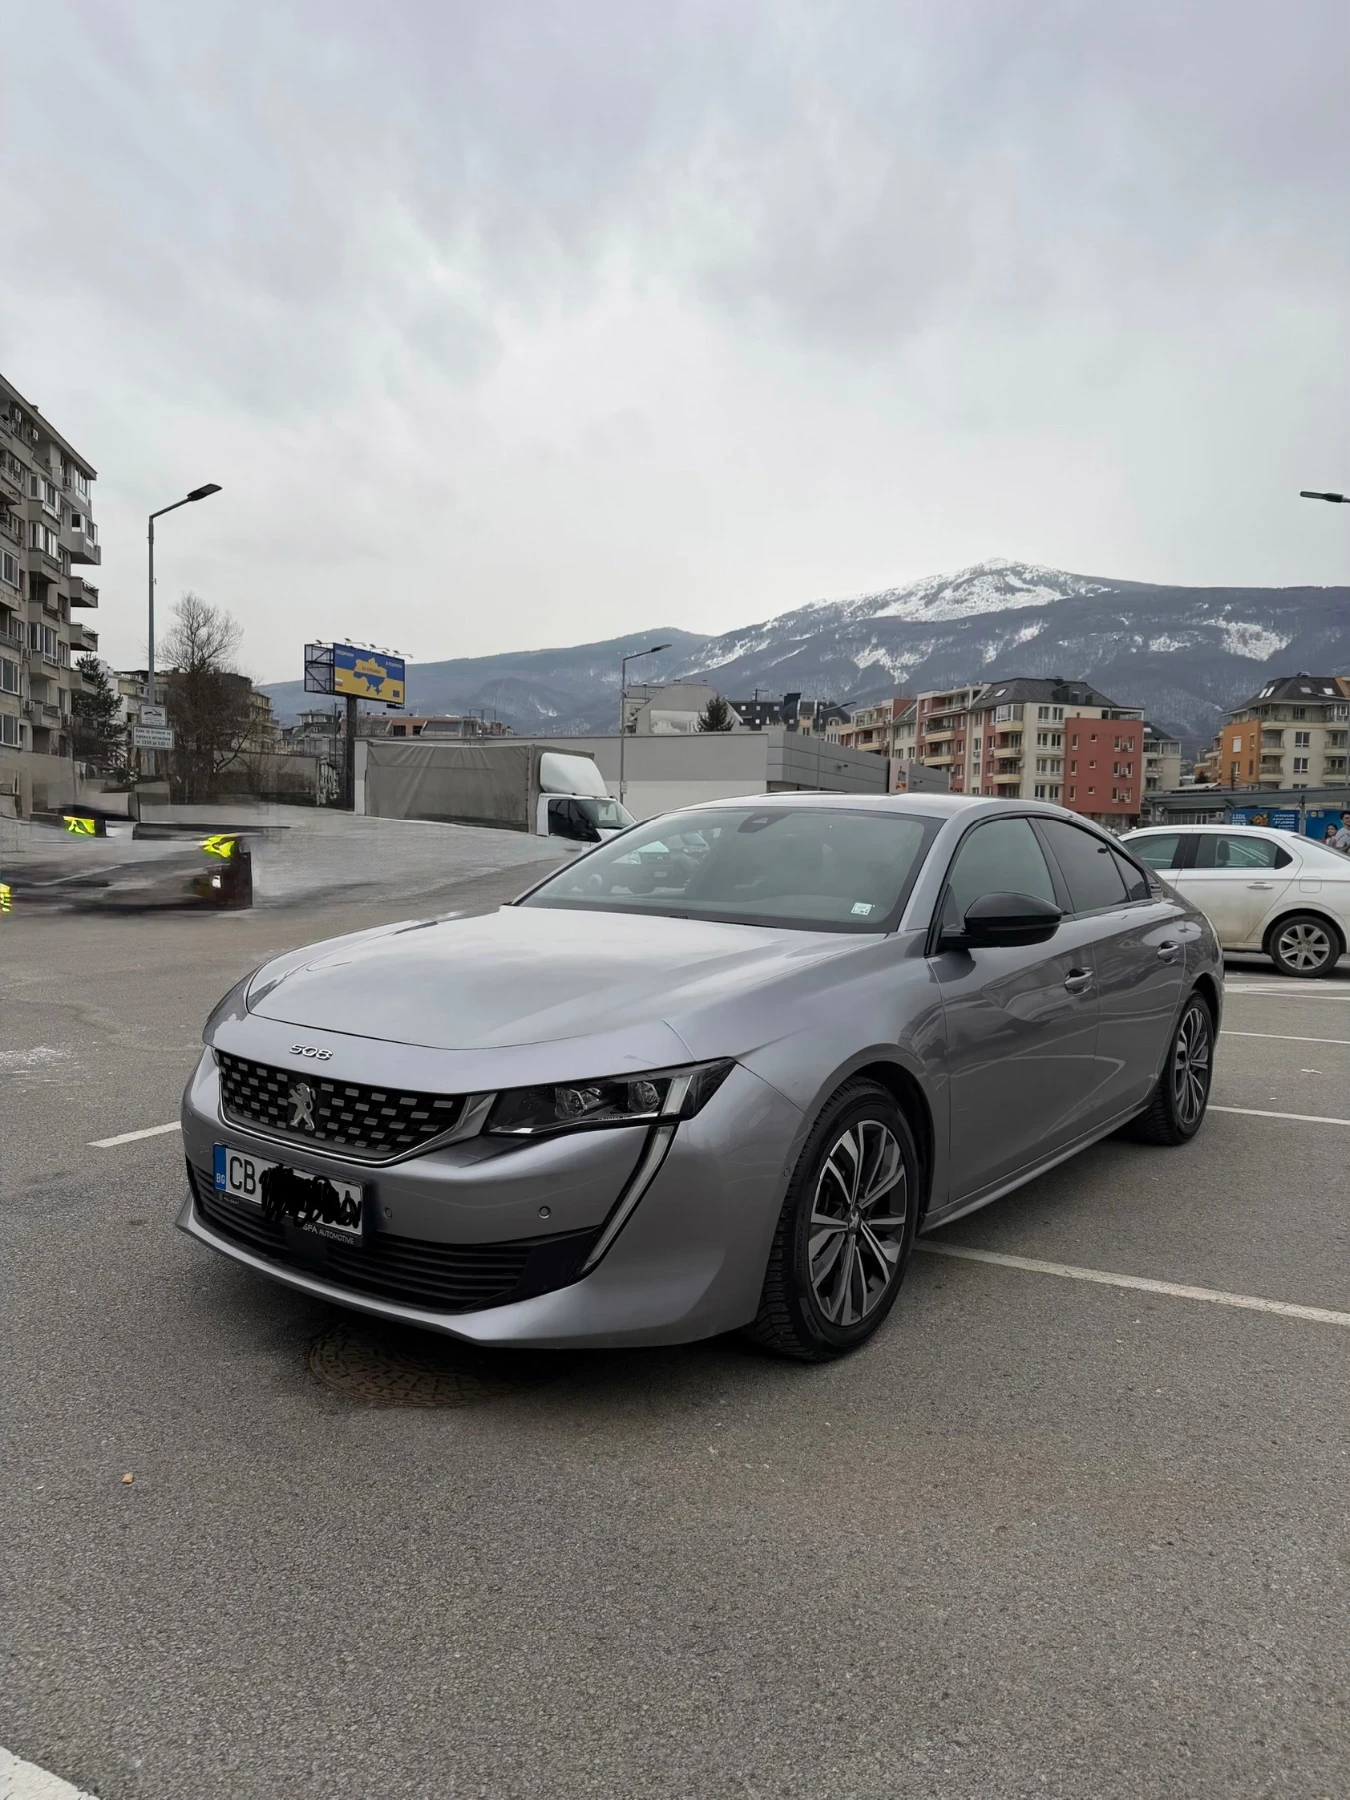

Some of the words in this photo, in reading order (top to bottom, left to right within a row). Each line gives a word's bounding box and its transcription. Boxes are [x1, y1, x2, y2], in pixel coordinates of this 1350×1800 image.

[289, 1044, 333, 1060] 508
[216, 1172, 226, 1185] BG
[230, 1156, 256, 1195] CB
[319, 1229, 354, 1245] AUTOMOTIVE
